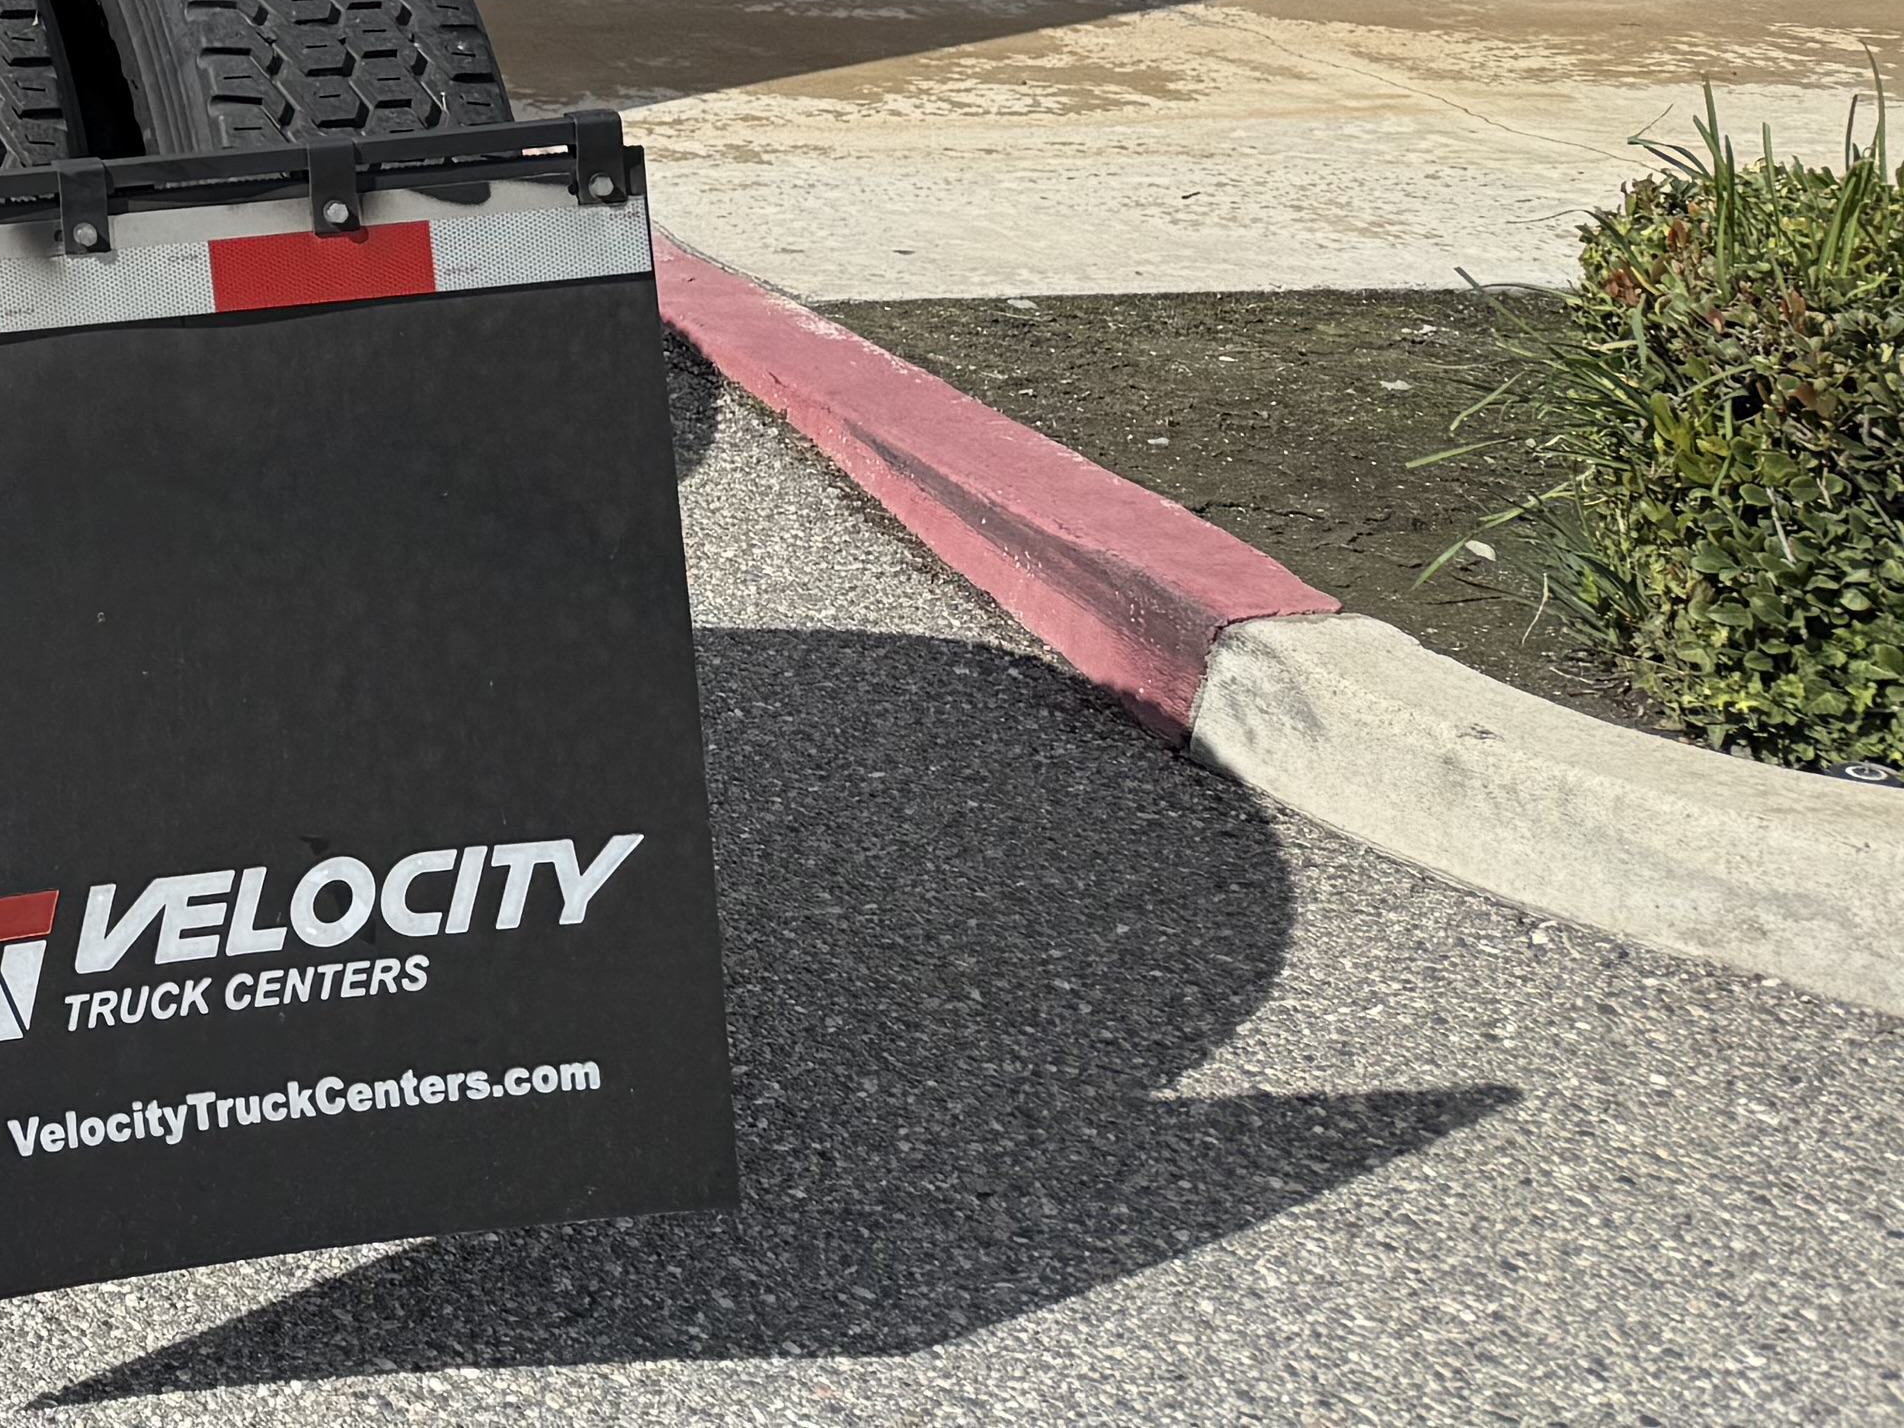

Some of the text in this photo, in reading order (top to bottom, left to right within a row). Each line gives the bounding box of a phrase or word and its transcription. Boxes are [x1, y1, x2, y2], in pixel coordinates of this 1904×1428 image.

[73, 832, 645, 975] VELOCITY
[63, 954, 431, 1032] TRUCK CENTERS
[7, 1058, 601, 1158] VelocityTruckCenters.com
